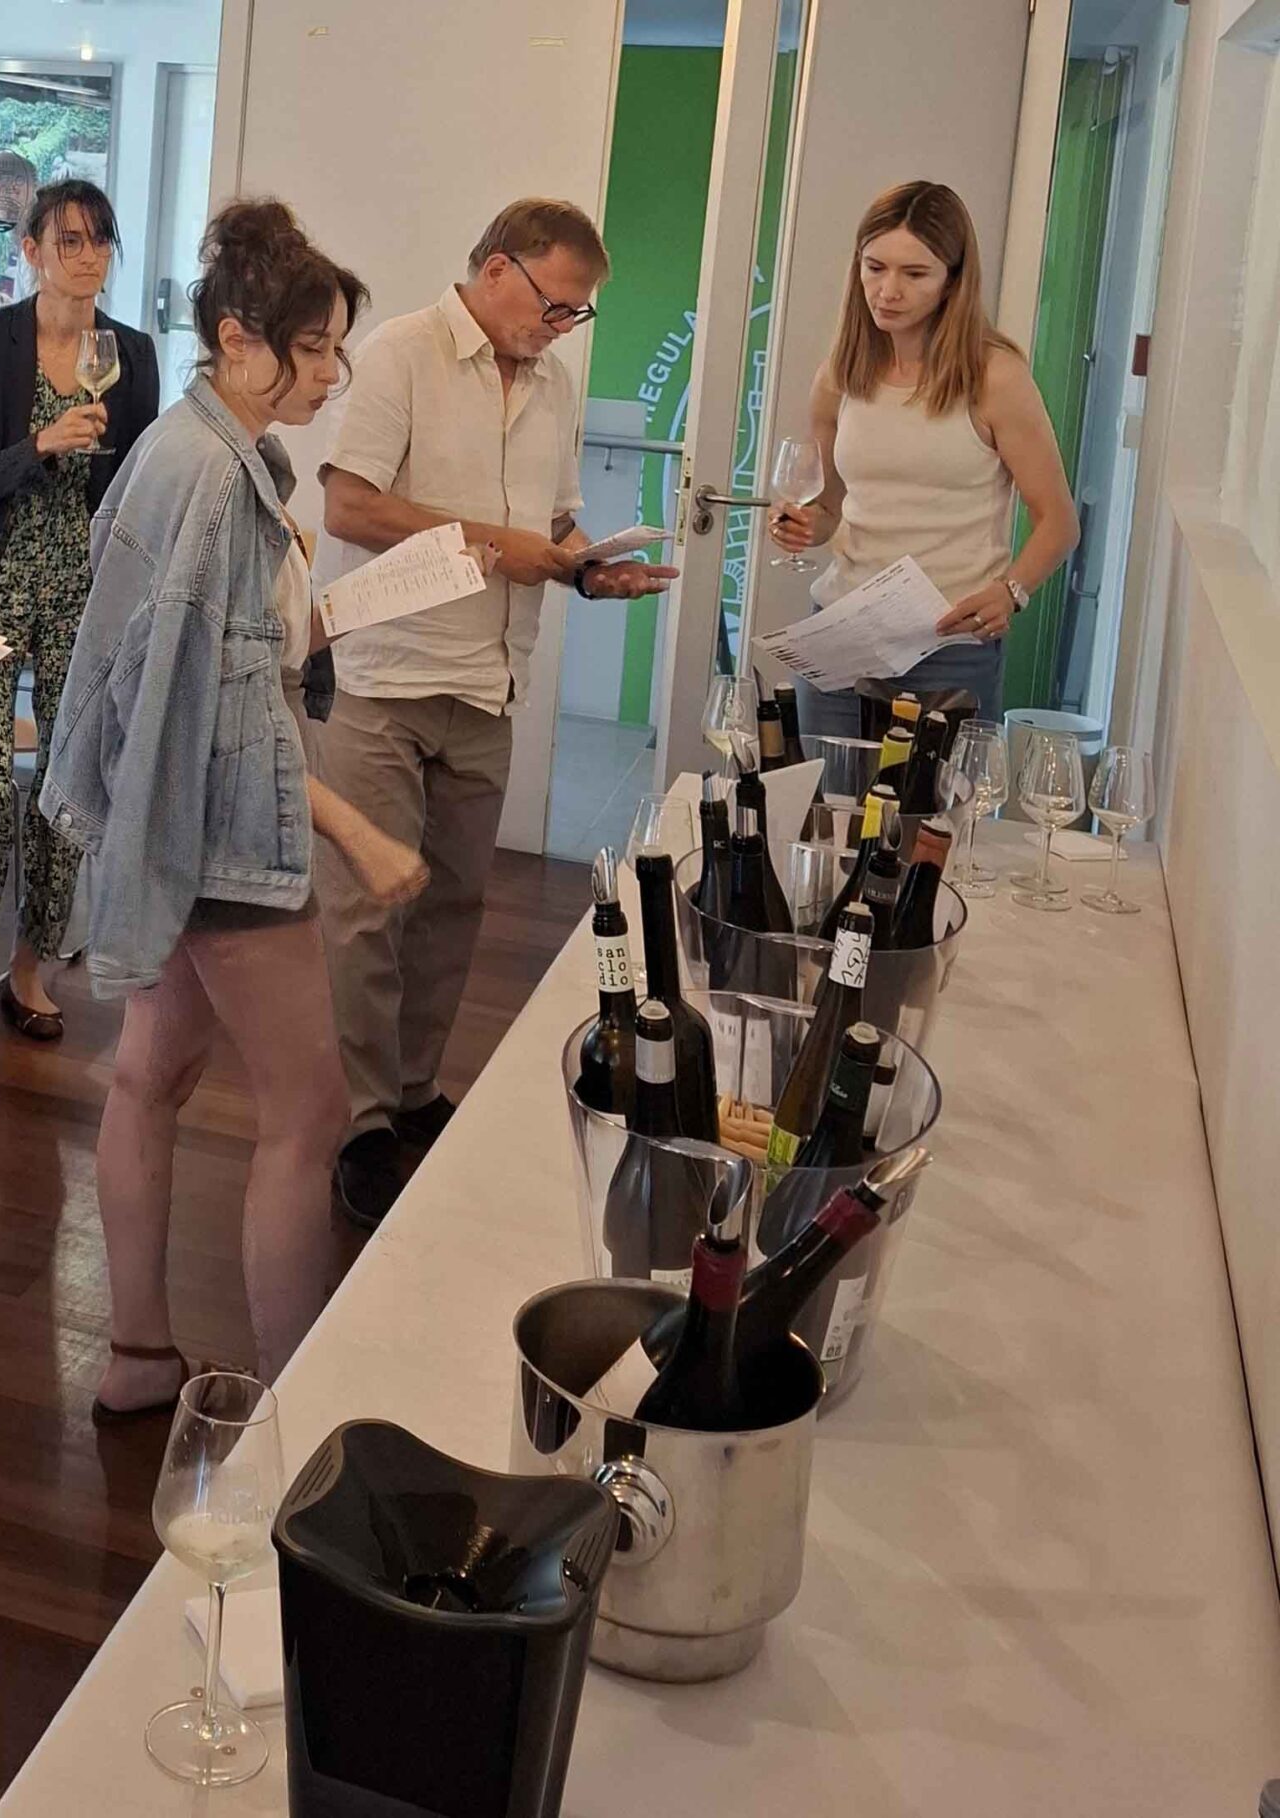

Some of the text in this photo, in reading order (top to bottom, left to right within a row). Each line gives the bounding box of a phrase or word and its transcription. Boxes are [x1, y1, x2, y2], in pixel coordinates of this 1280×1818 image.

[597, 947, 625, 959] san
[598, 959, 626, 972] clo
[599, 972, 628, 986] dio
